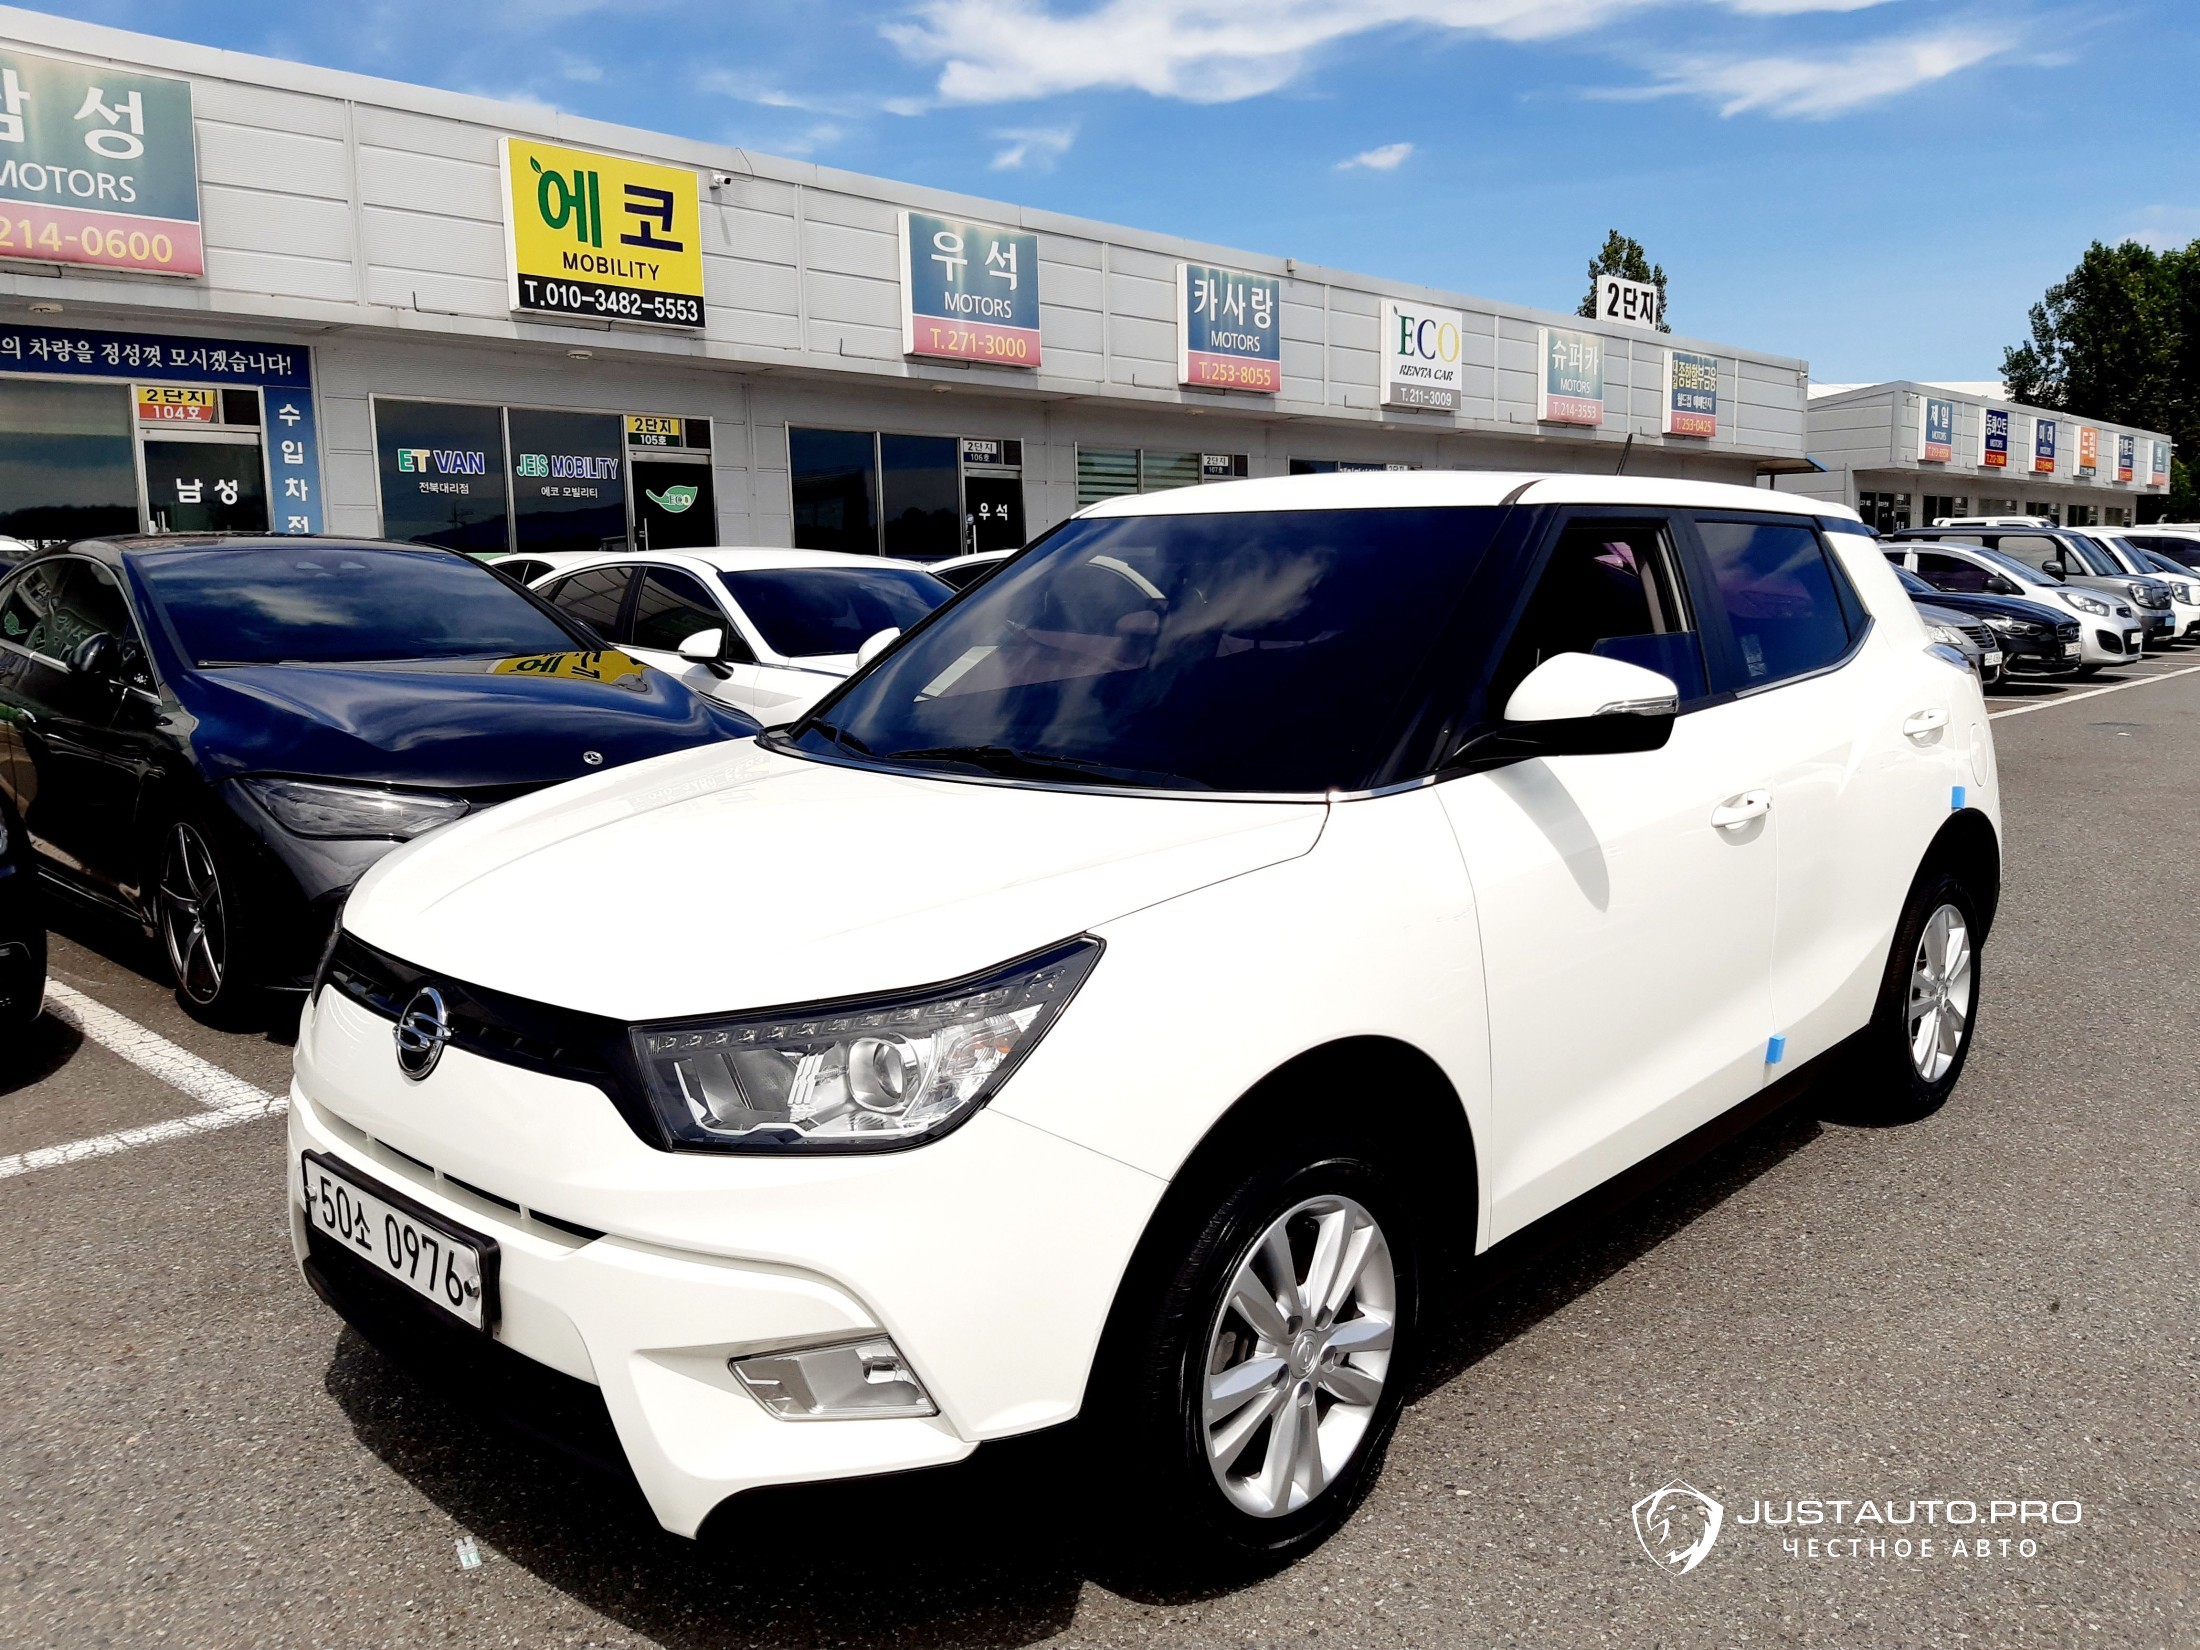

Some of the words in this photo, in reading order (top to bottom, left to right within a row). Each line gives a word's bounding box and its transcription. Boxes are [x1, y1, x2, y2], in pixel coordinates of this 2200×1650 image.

[0, 159, 137, 203] MOTORS
[537, 169, 684, 253] 에코
[0, 217, 173, 264] 214-0600
[562, 251, 660, 281] MOBILITY
[930, 231, 1018, 291] 우석
[524, 280, 698, 322] T.010-3482-5553
[944, 291, 1012, 319] MOTORS
[1193, 278, 1273, 329] 카사랑
[1607, 282, 1654, 325] 2단지
[1211, 330, 1261, 352] MOTORS
[1397, 314, 1460, 363] ECO
[28, 337, 95, 363] 차량을
[100, 342, 164, 368] 정성껏
[169, 348, 293, 376] 모시겠습니다!
[1551, 340, 1599, 376] 슈퍼카
[1199, 361, 1271, 386] T.253-8055
[1398, 364, 1432, 379] RENTA
[1433, 369, 1454, 382] CAR
[1560, 377, 1591, 395] MOTORS
[146, 389, 206, 406] 2단지
[1400, 387, 1452, 407] T.211-3009
[1552, 401, 1597, 419] T.214-3553
[153, 405, 202, 420] 104호
[634, 417, 672, 434] 2단지
[639, 434, 668, 446] 105호
[967, 442, 993, 452] 2단지
[397, 448, 430, 473] ET
[433, 450, 486, 475] VAN
[516, 453, 550, 478] JEIS
[551, 455, 619, 480] MOBILITY
[970, 453, 990, 463] 106호
[1206, 456, 1226, 466] 2단지
[175, 477, 240, 506] 남성
[418, 481, 470, 495] 전북대리점
[541, 485, 560, 498] 에코
[562, 486, 599, 499] 모빌리티
[978, 502, 1008, 521] 우석
[320, 1175, 372, 1251] 50소
[384, 1213, 464, 1307] 0976
